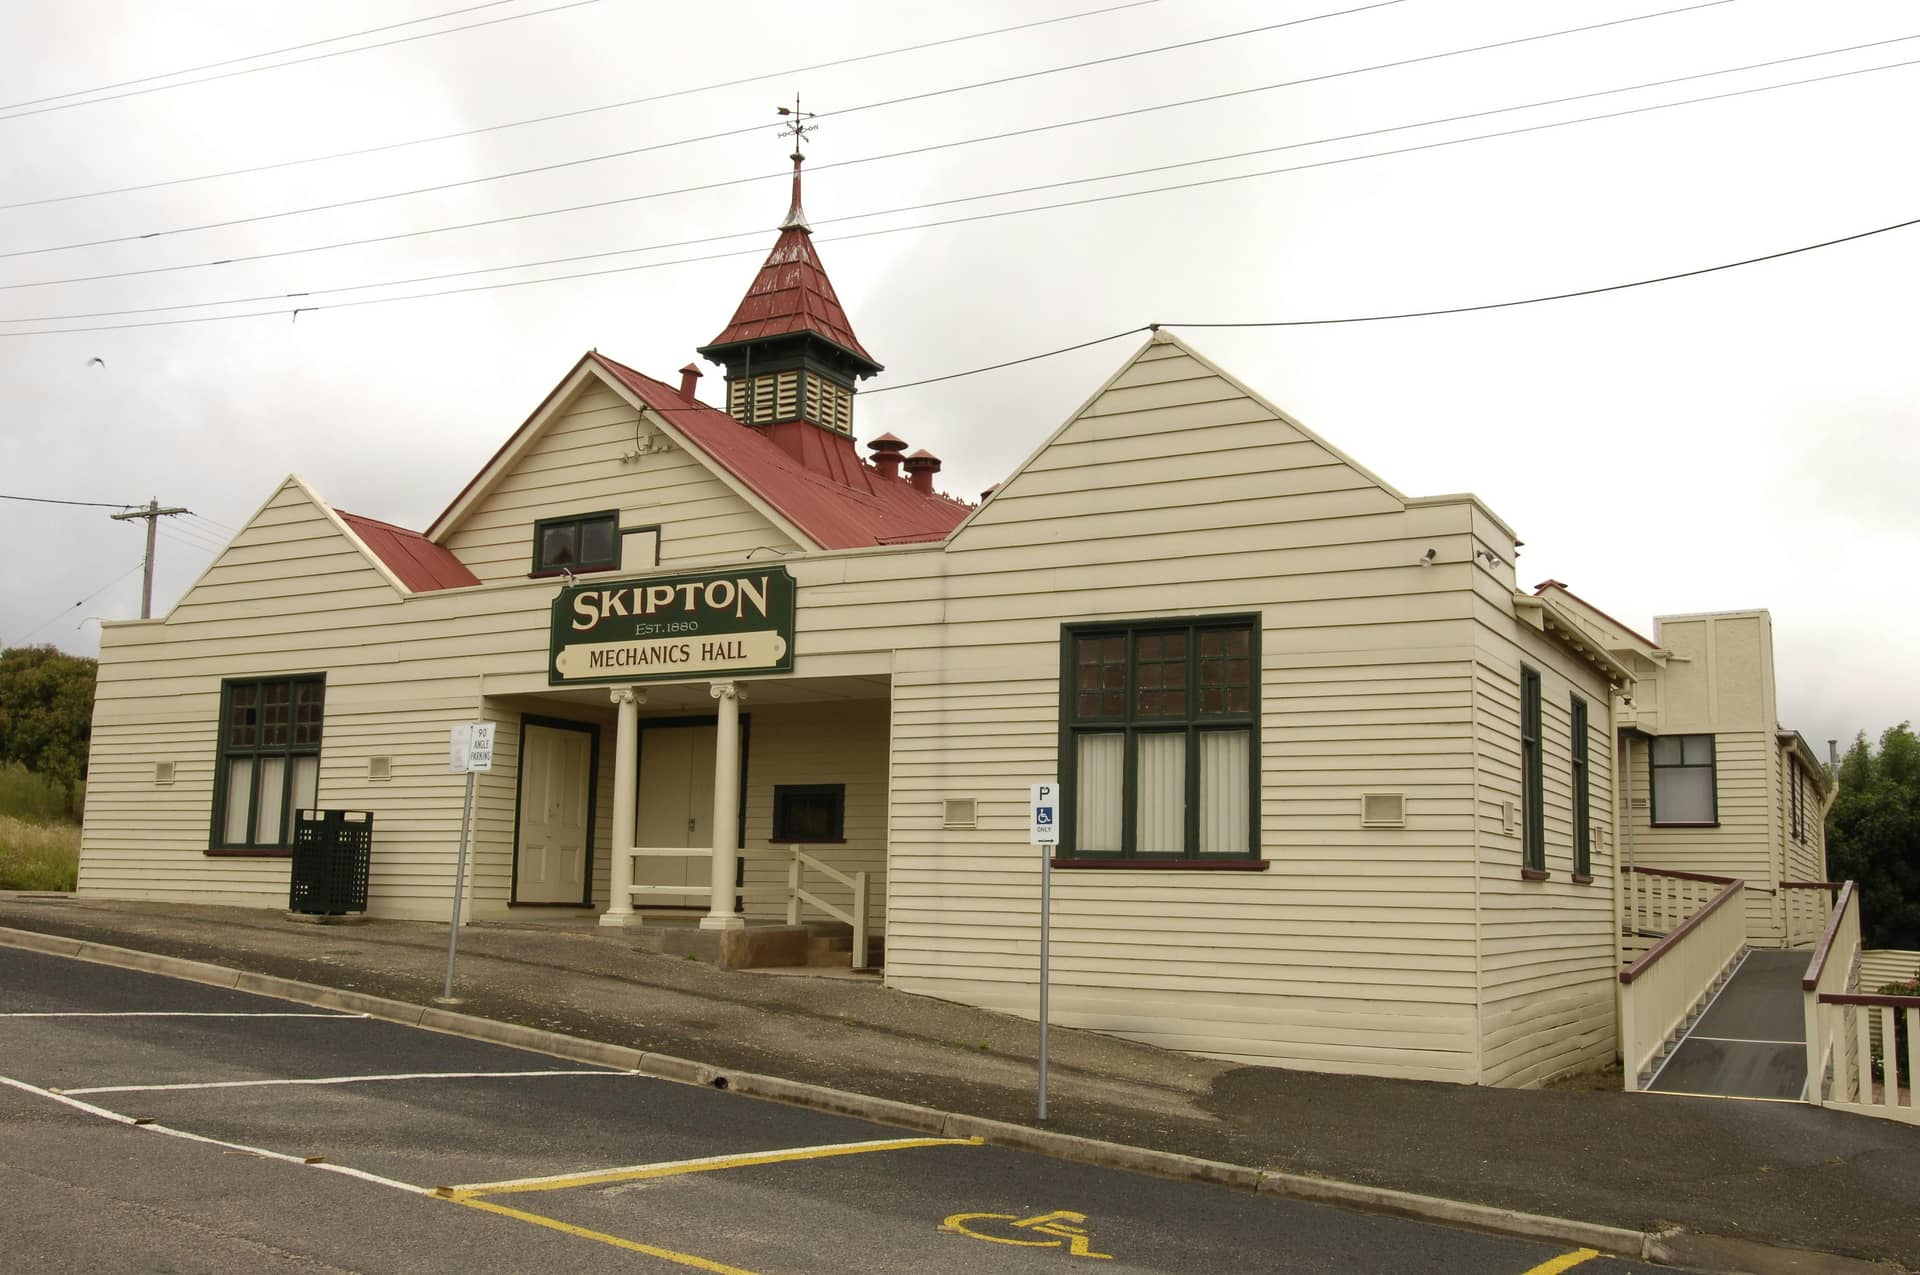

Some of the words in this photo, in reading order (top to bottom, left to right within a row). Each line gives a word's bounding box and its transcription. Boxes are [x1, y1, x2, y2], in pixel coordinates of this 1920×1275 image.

[572, 576, 770, 631] SKIPTON
[589, 644, 690, 668] MECHANICS
[701, 641, 747, 662] HALL
[473, 740, 489, 749] ANGLE
[470, 751, 491, 761] PARKING
[1039, 786, 1050, 801] P
